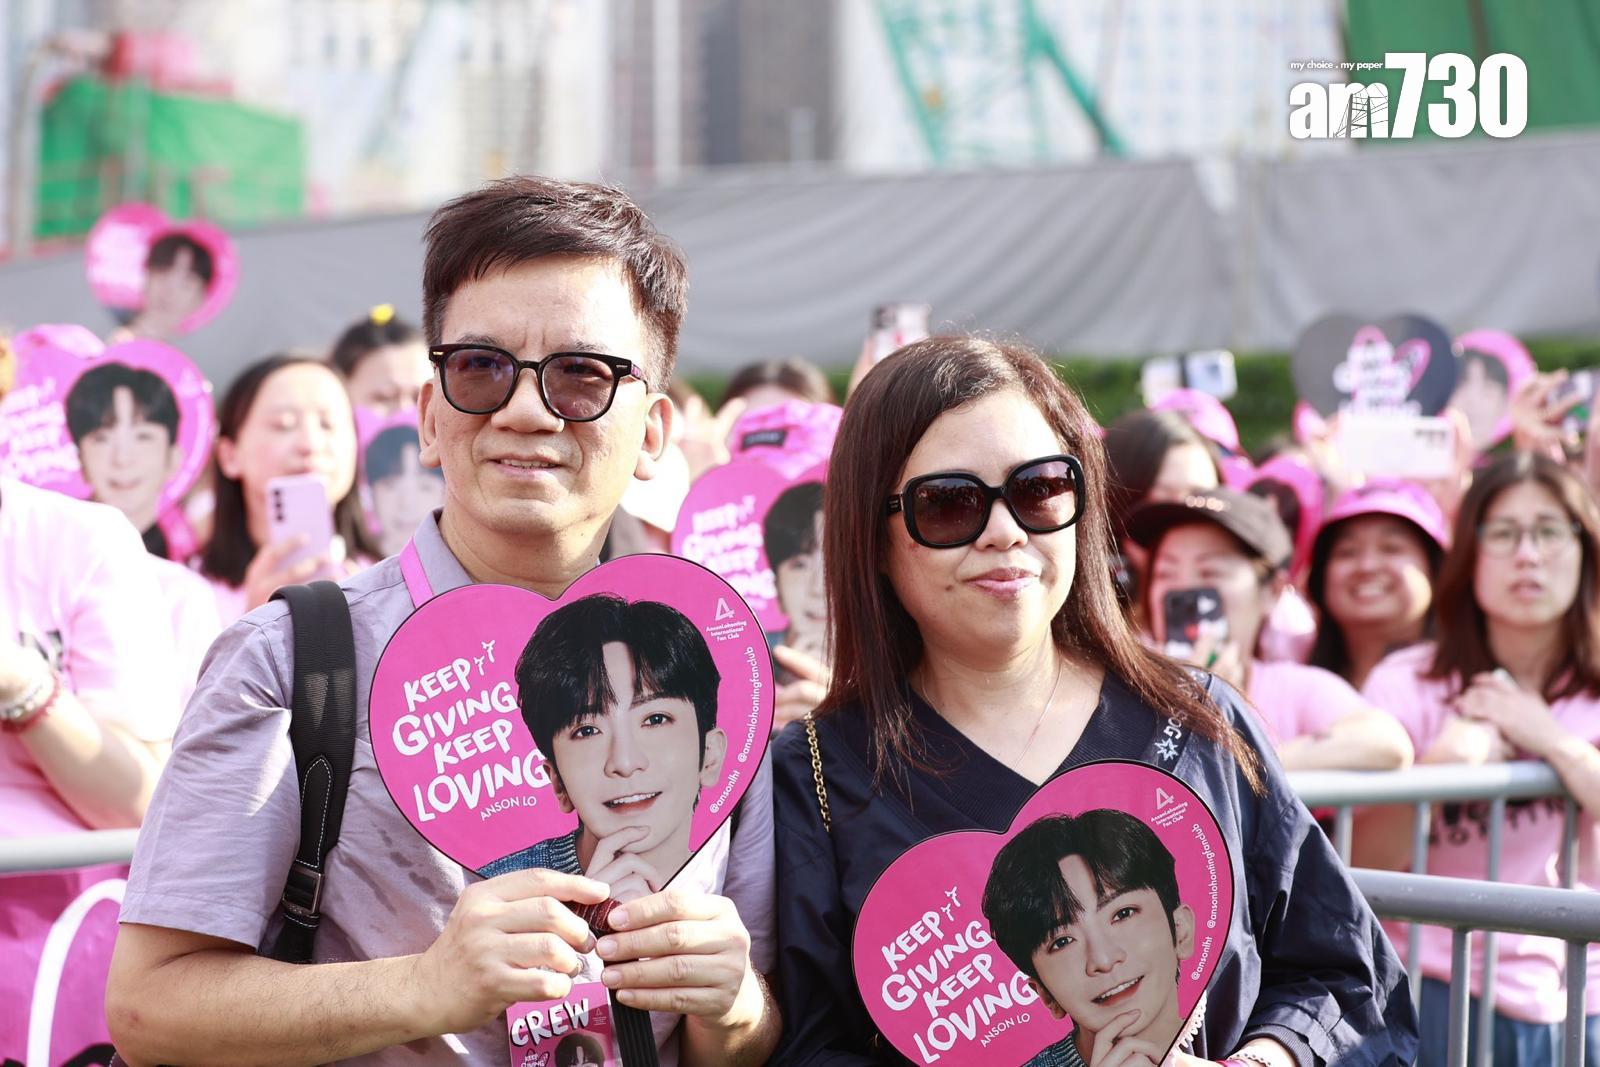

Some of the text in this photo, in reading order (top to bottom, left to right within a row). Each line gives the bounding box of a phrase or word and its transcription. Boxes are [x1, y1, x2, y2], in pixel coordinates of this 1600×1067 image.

[403, 658, 471, 712] KEEP
[737, 646, 763, 763] @ansonlohontingfanclub
[392, 682, 518, 756] GIVING
[433, 719, 513, 774] KEEP
[413, 749, 552, 821] LOVING
[480, 796, 537, 821] ANSON LO
[709, 769, 741, 814] @ansonlht
[1192, 823, 1219, 929] @ansonlohontingfanclub
[881, 911, 945, 973] KEEP
[881, 920, 993, 1011] GIVING
[1191, 935, 1213, 981] @ansonlht
[913, 970, 1040, 1064] LOVING
[923, 953, 995, 1019] KEEP
[510, 998, 589, 1047] CREW
[980, 1013, 1031, 1048] ANSON LO
